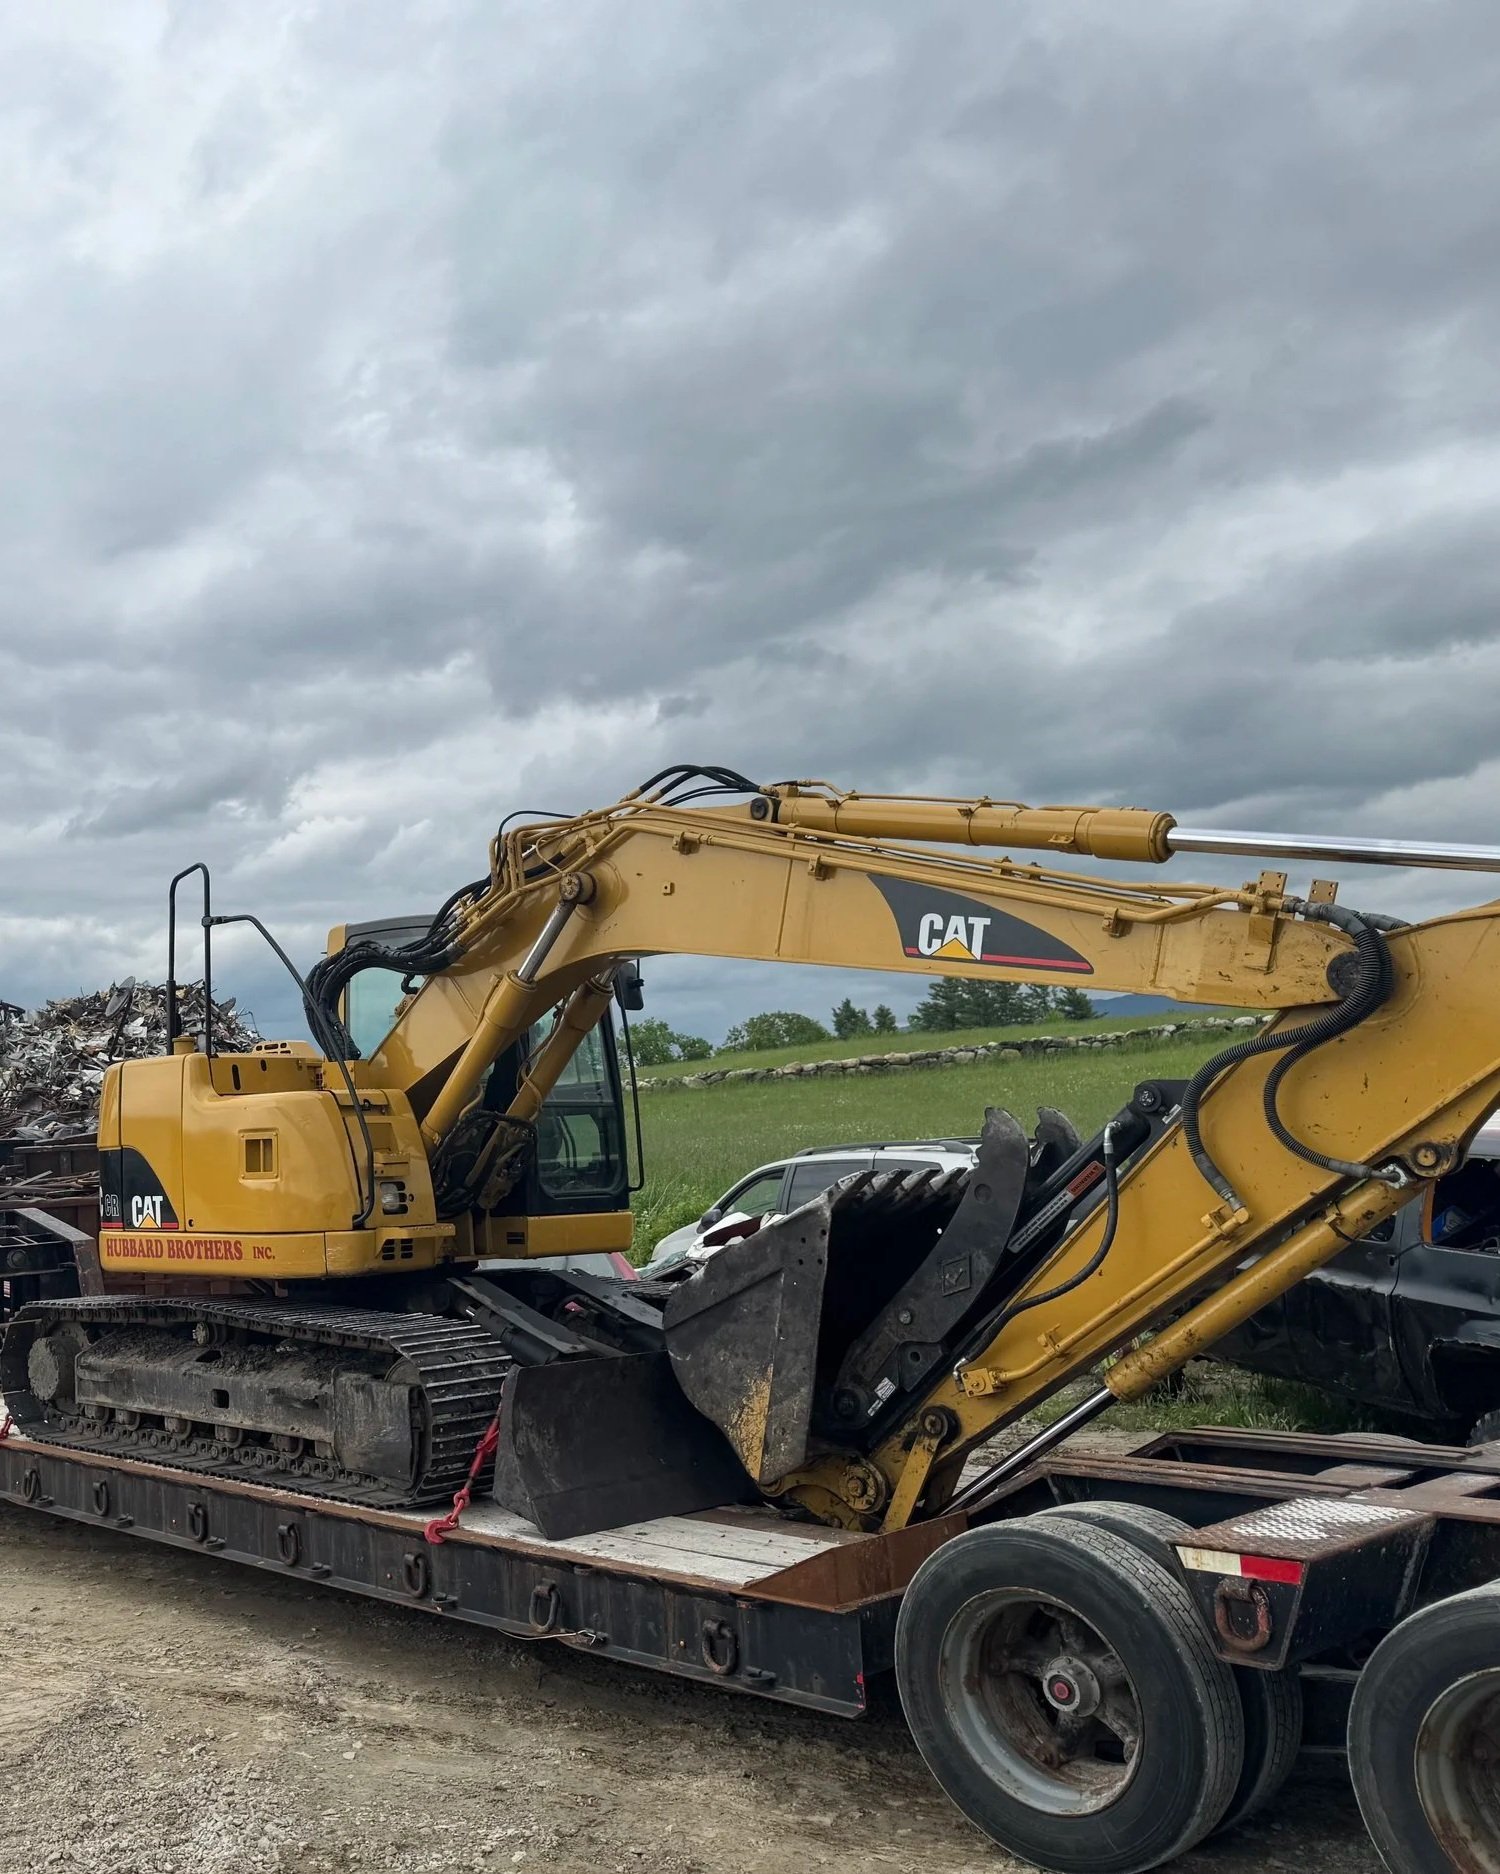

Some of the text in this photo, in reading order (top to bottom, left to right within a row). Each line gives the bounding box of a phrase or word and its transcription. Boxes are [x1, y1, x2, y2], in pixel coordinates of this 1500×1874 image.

[918, 912, 991, 960] CAT
[105, 1193, 119, 1216] CR
[132, 1195, 163, 1228] CAT
[106, 1238, 276, 1261] HUBBARD BROTHERS INC.
